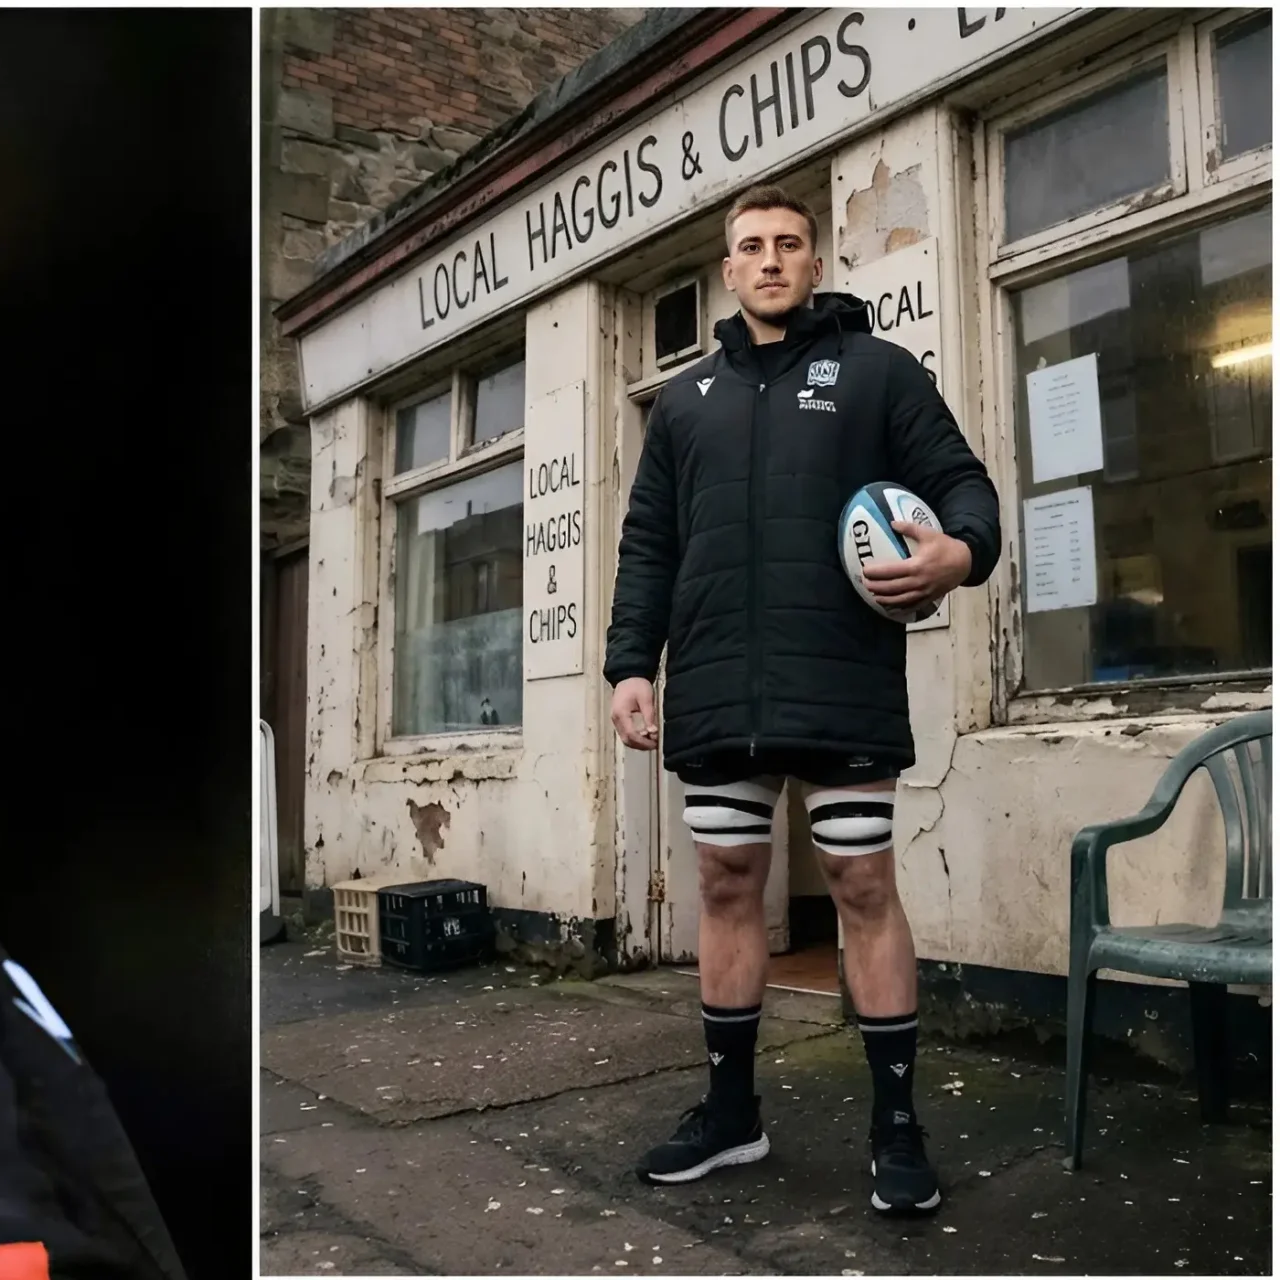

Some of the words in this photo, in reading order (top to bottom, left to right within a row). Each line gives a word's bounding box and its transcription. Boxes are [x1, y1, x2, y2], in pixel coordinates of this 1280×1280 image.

[418, 232, 508, 330] LOCAL
[526, 134, 663, 272] HAGGIS
[681, 131, 703, 181] &
[719, 12, 872, 162] CHIPS
[866, 281, 933, 334] OCAL
[529, 452, 580, 499] LOCAL
[526, 510, 581, 558] HAGGIS
[547, 565, 557, 594] &
[529, 602, 577, 644] CHIPS
